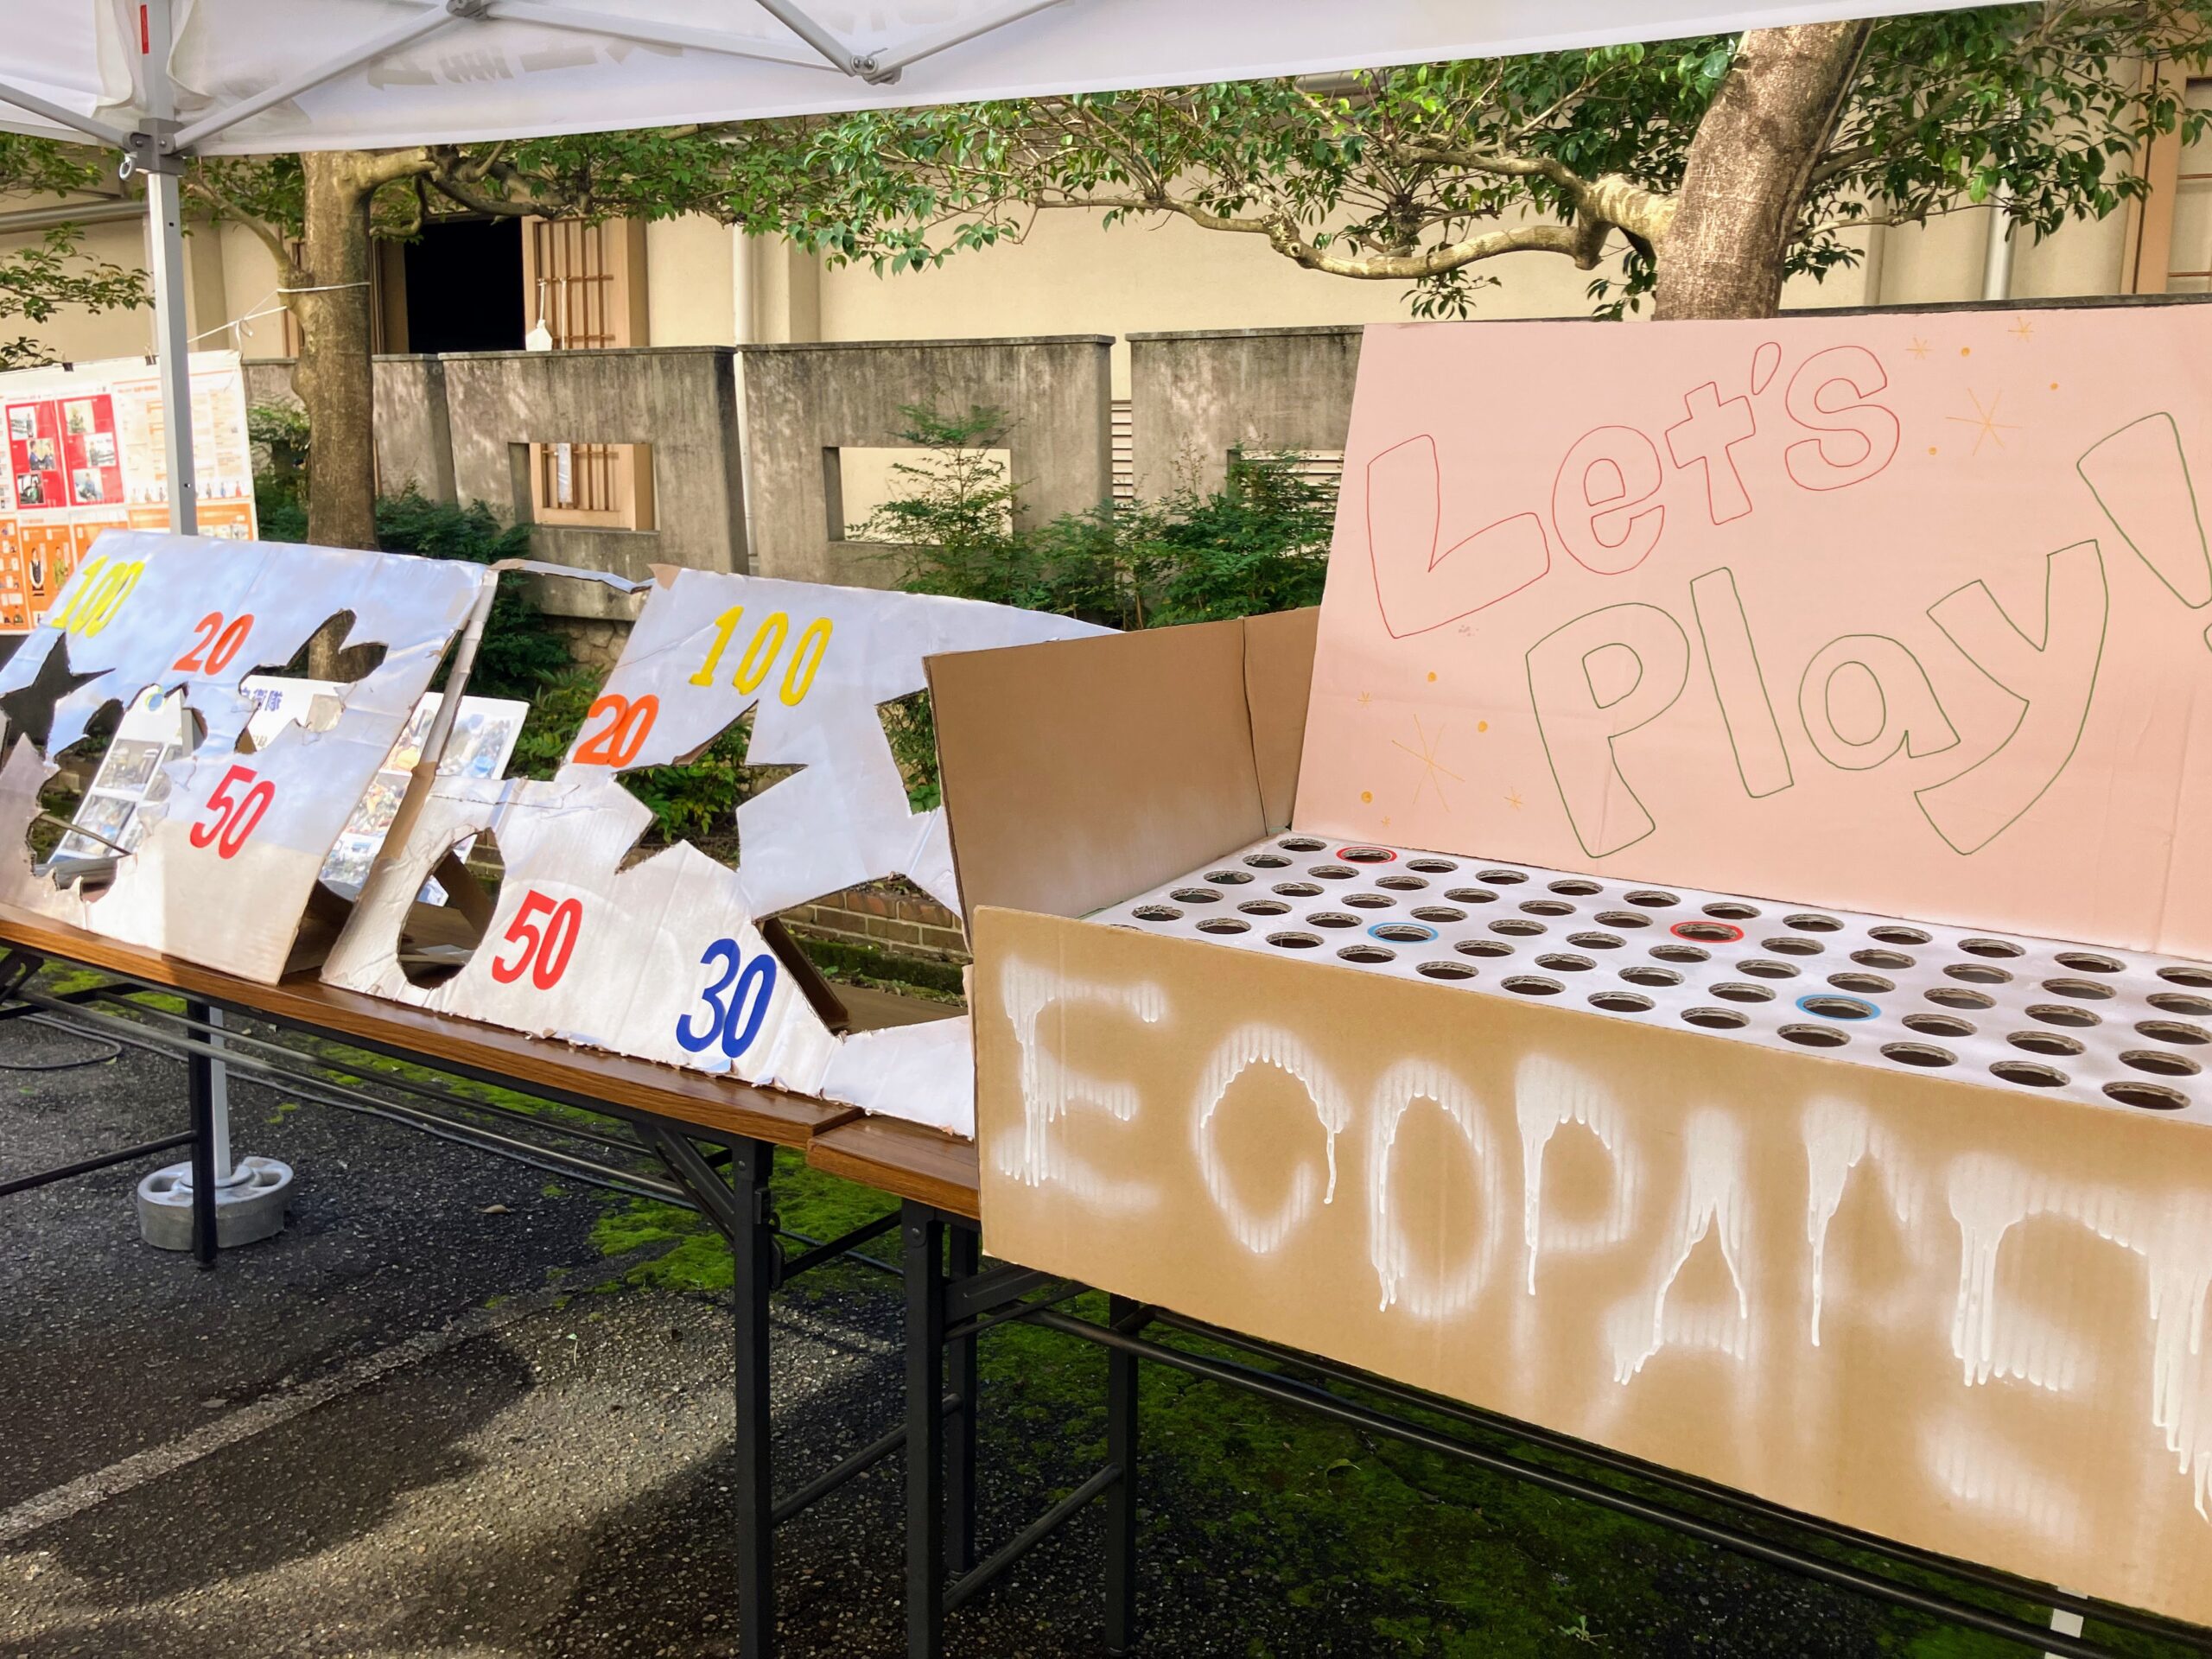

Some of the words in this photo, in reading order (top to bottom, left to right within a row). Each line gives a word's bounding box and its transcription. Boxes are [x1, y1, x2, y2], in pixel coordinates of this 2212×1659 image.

[1368, 341, 1900, 639] Let's
[50, 555, 146, 638] 100
[173, 612, 254, 676] 20
[1526, 411, 2212, 858] Play!
[689, 606, 833, 707] 100
[572, 694, 658, 768] 20
[189, 765, 276, 860] 50
[492, 889, 583, 991] 50
[676, 938, 776, 1058] 30
